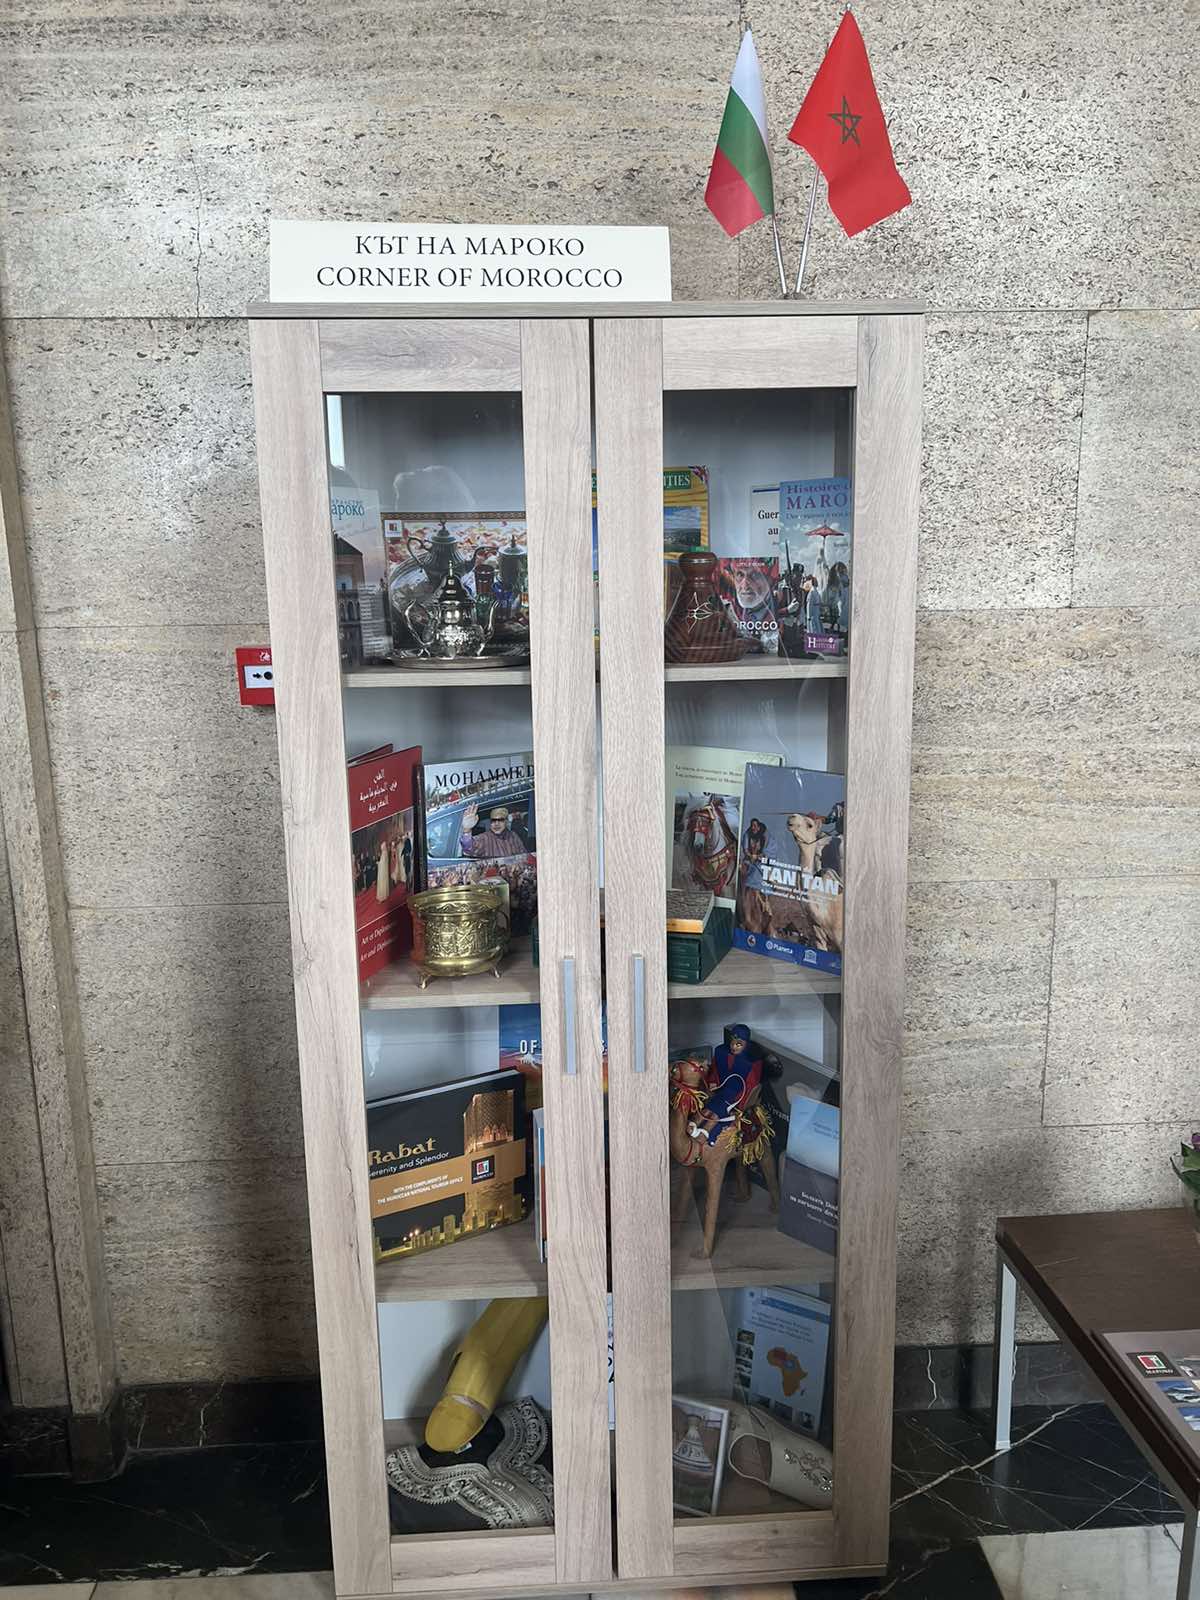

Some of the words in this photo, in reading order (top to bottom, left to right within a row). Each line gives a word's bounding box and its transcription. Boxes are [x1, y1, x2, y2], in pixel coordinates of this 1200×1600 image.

[355, 235, 408, 254] КЪТ
[416, 236, 456, 255] НА
[465, 237, 584, 256] МАРОКО
[317, 266, 430, 287] CORNER
[438, 267, 472, 287] OF
[480, 267, 623, 287] MOROCCO
[787, 484, 838, 494] Histoire
[768, 527, 779, 535] au
[435, 764, 535, 788] MOHAMMED
[761, 864, 797, 887] TAN
[801, 873, 839, 896] TAN
[520, 1039, 538, 1054] OF
[367, 1137, 436, 1166] Rabat
[399, 1160, 415, 1171] and
[415, 1151, 450, 1167] Splendor
